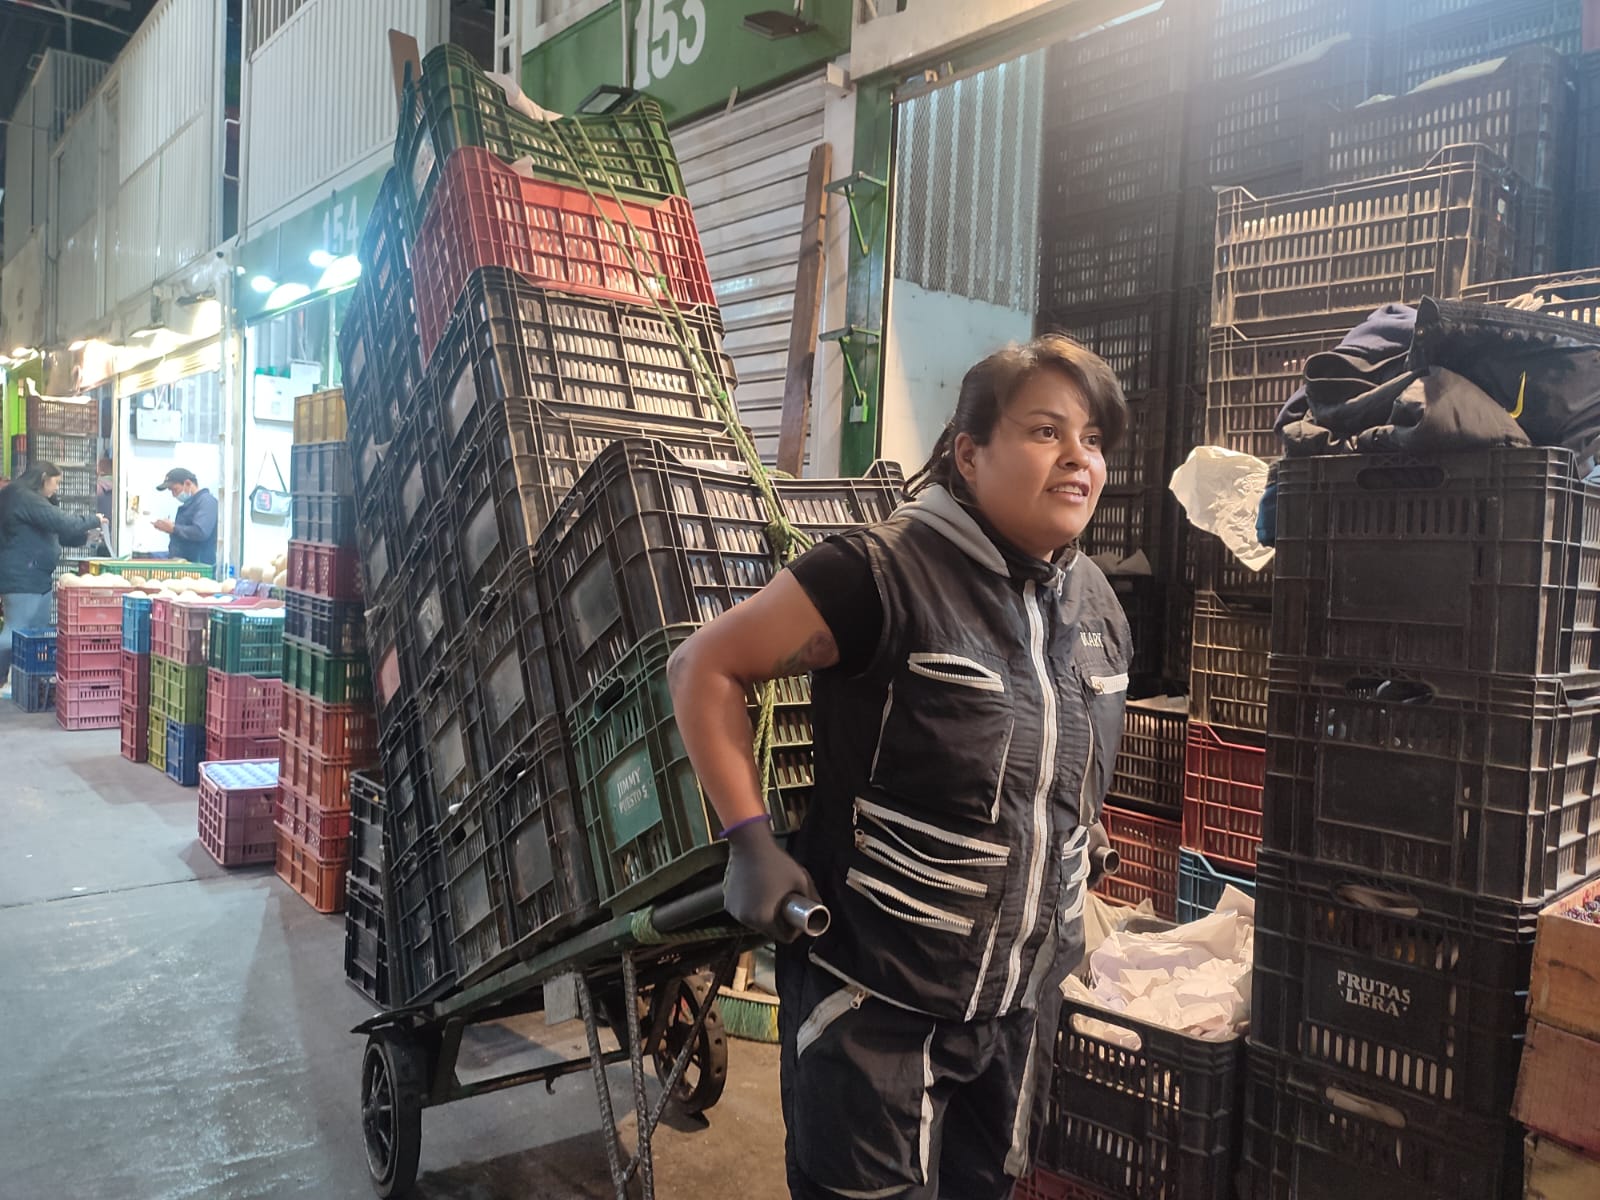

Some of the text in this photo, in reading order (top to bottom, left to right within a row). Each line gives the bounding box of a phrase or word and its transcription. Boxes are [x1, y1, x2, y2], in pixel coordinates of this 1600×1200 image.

[633, 0, 706, 90] 153
[323, 196, 360, 254] 154
[1337, 969, 1411, 1005] FRUTAS
[1345, 988, 1400, 1017] LERA
